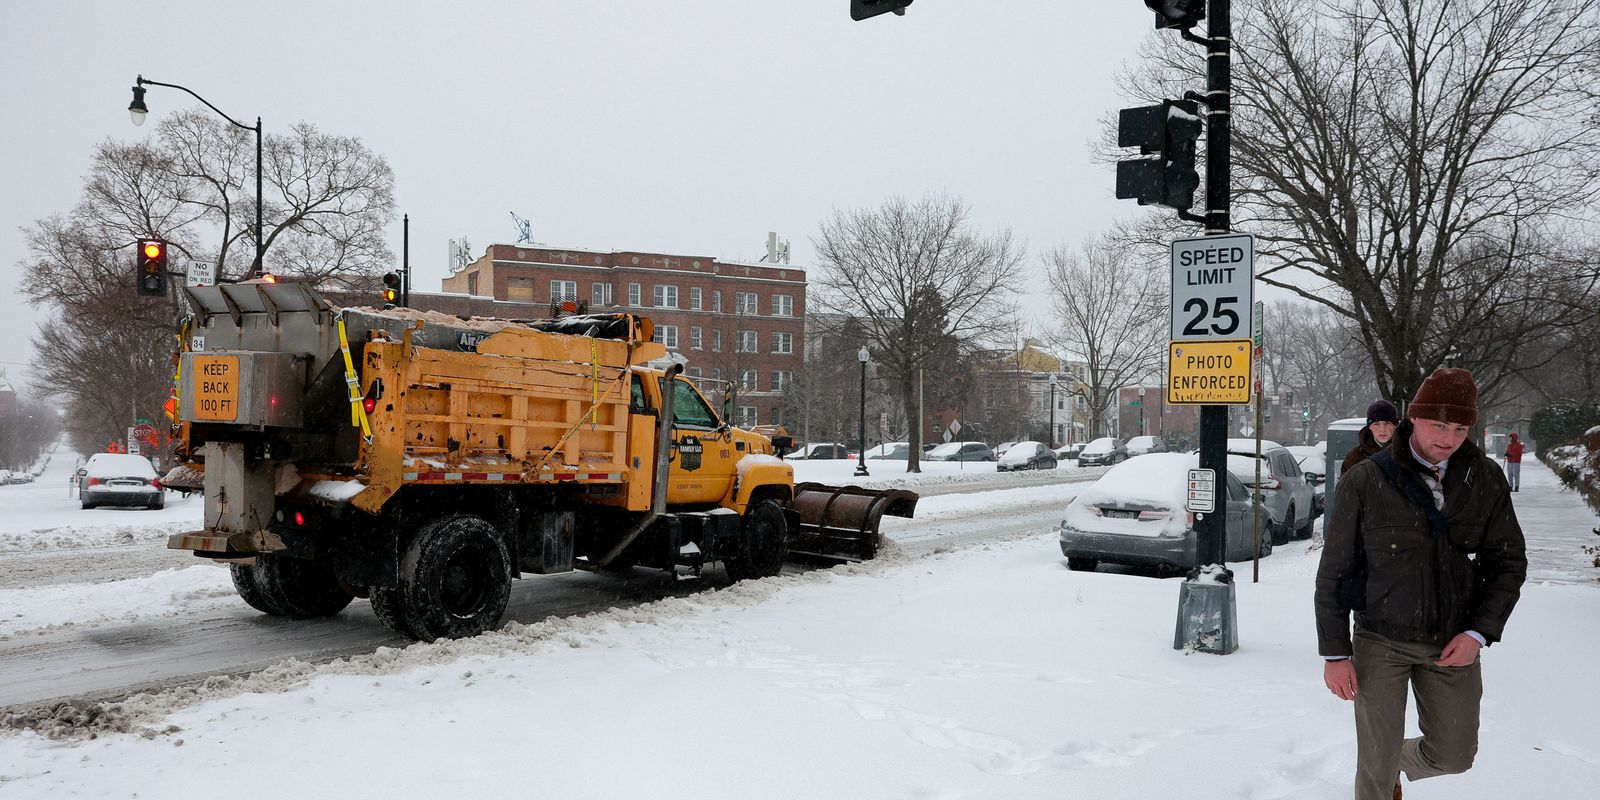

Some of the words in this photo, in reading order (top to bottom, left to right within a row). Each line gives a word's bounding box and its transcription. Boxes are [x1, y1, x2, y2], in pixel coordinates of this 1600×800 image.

[1180, 247, 1244, 266] SPEED
[1187, 267, 1236, 285] LIMIT
[1182, 296, 1240, 336] 25
[193, 339, 203, 348] 34
[1187, 355, 1232, 369] PHOTO
[203, 364, 229, 375] KEEP
[203, 381, 229, 393] BACK
[1173, 375, 1246, 389] ENFORCED
[201, 399, 217, 411] 100
[220, 399, 231, 411] FT
